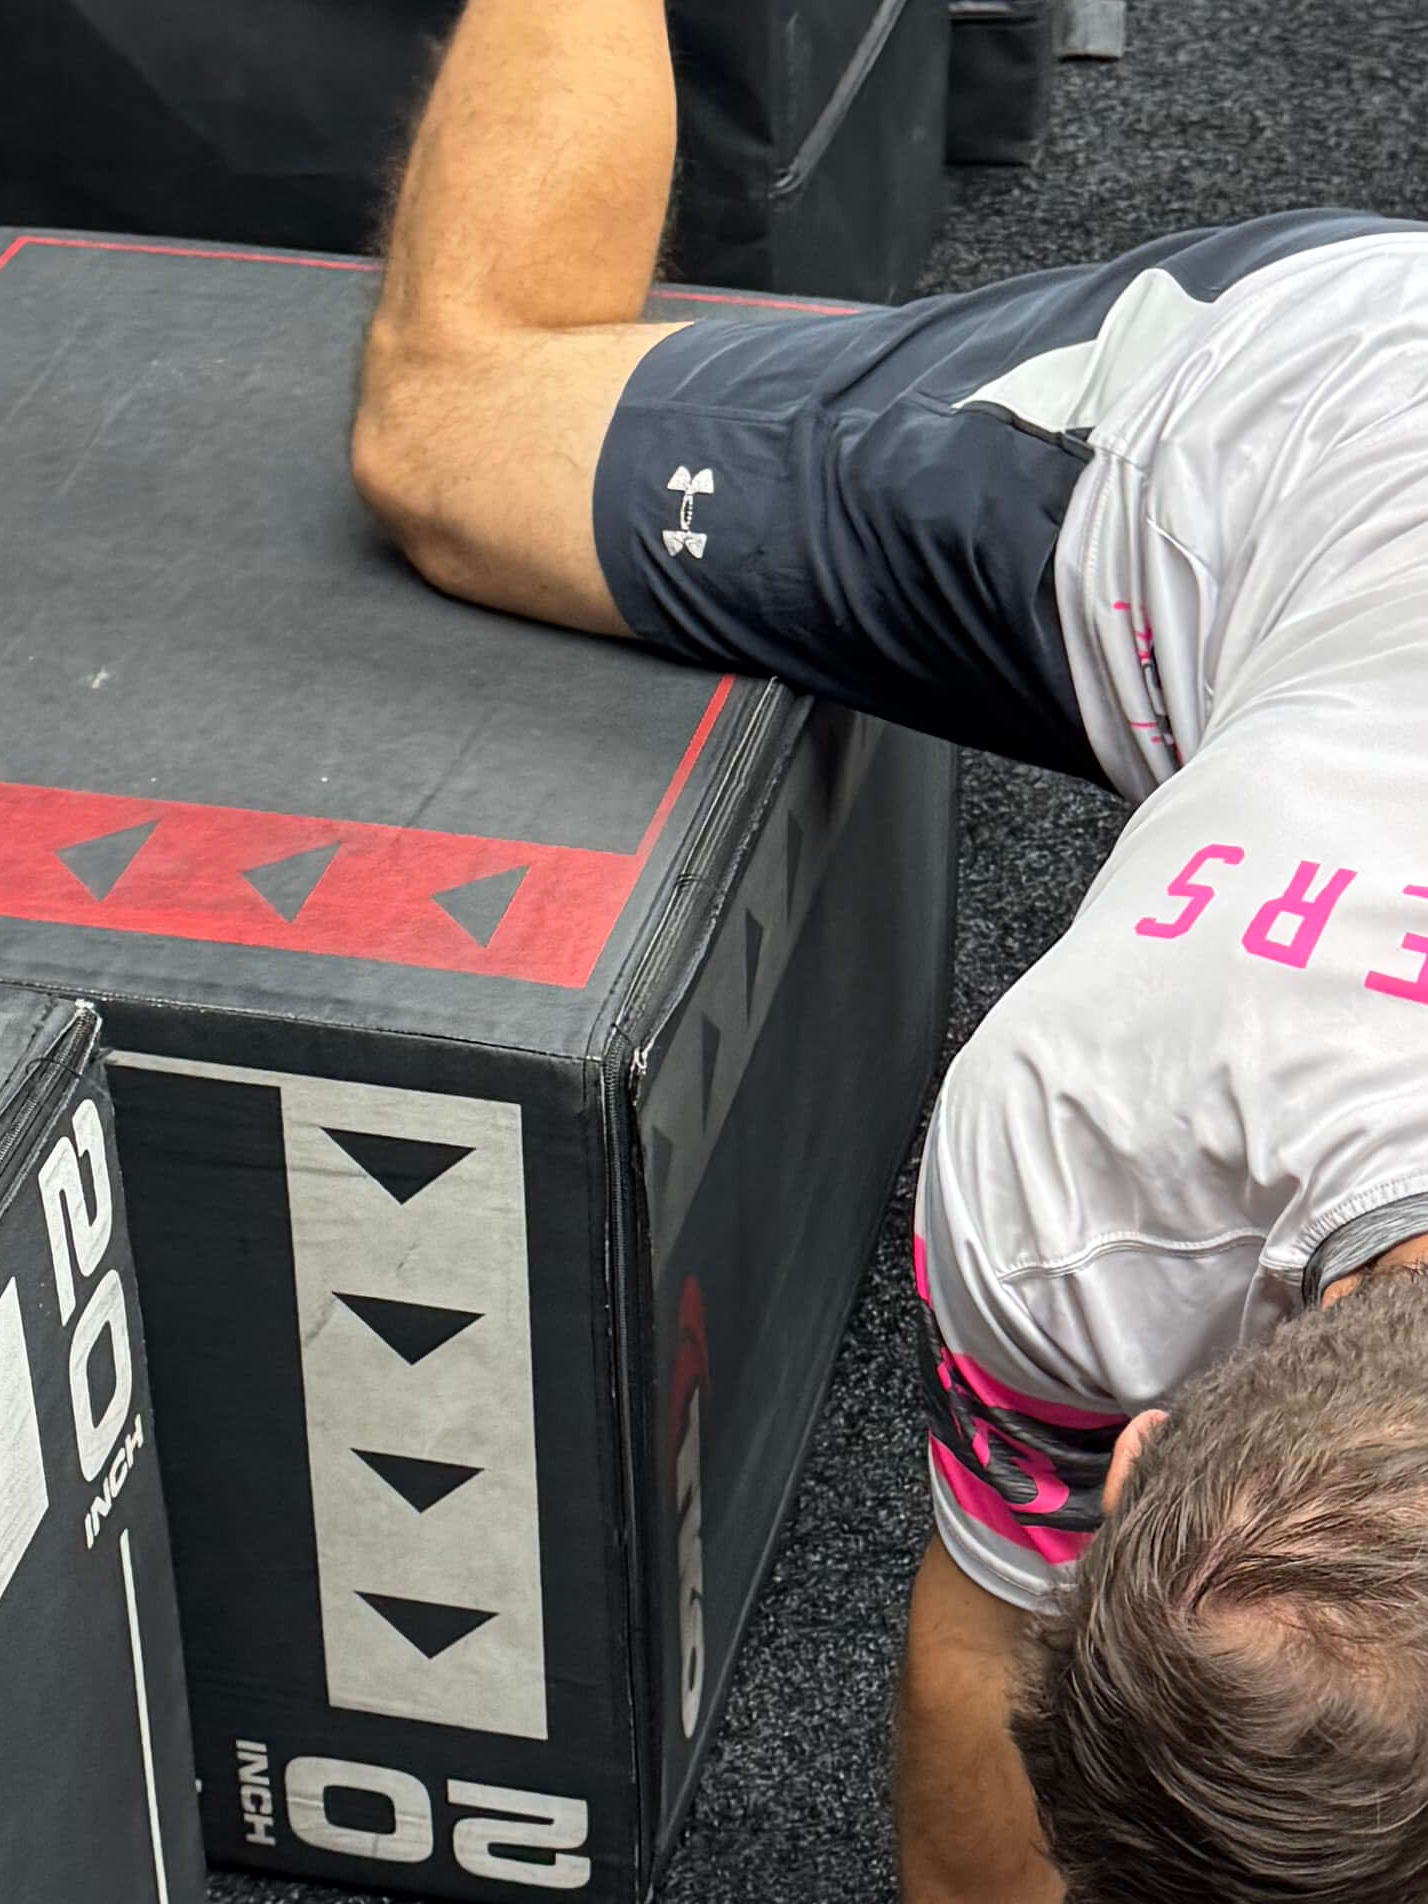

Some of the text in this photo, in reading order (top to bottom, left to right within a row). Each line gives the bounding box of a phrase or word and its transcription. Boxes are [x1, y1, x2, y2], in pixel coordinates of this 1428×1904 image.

[38, 1098, 133, 1482] 20
[84, 1411, 145, 1550] INCH
[235, 1738, 276, 1847] INCH
[284, 1755, 591, 1890] 20
